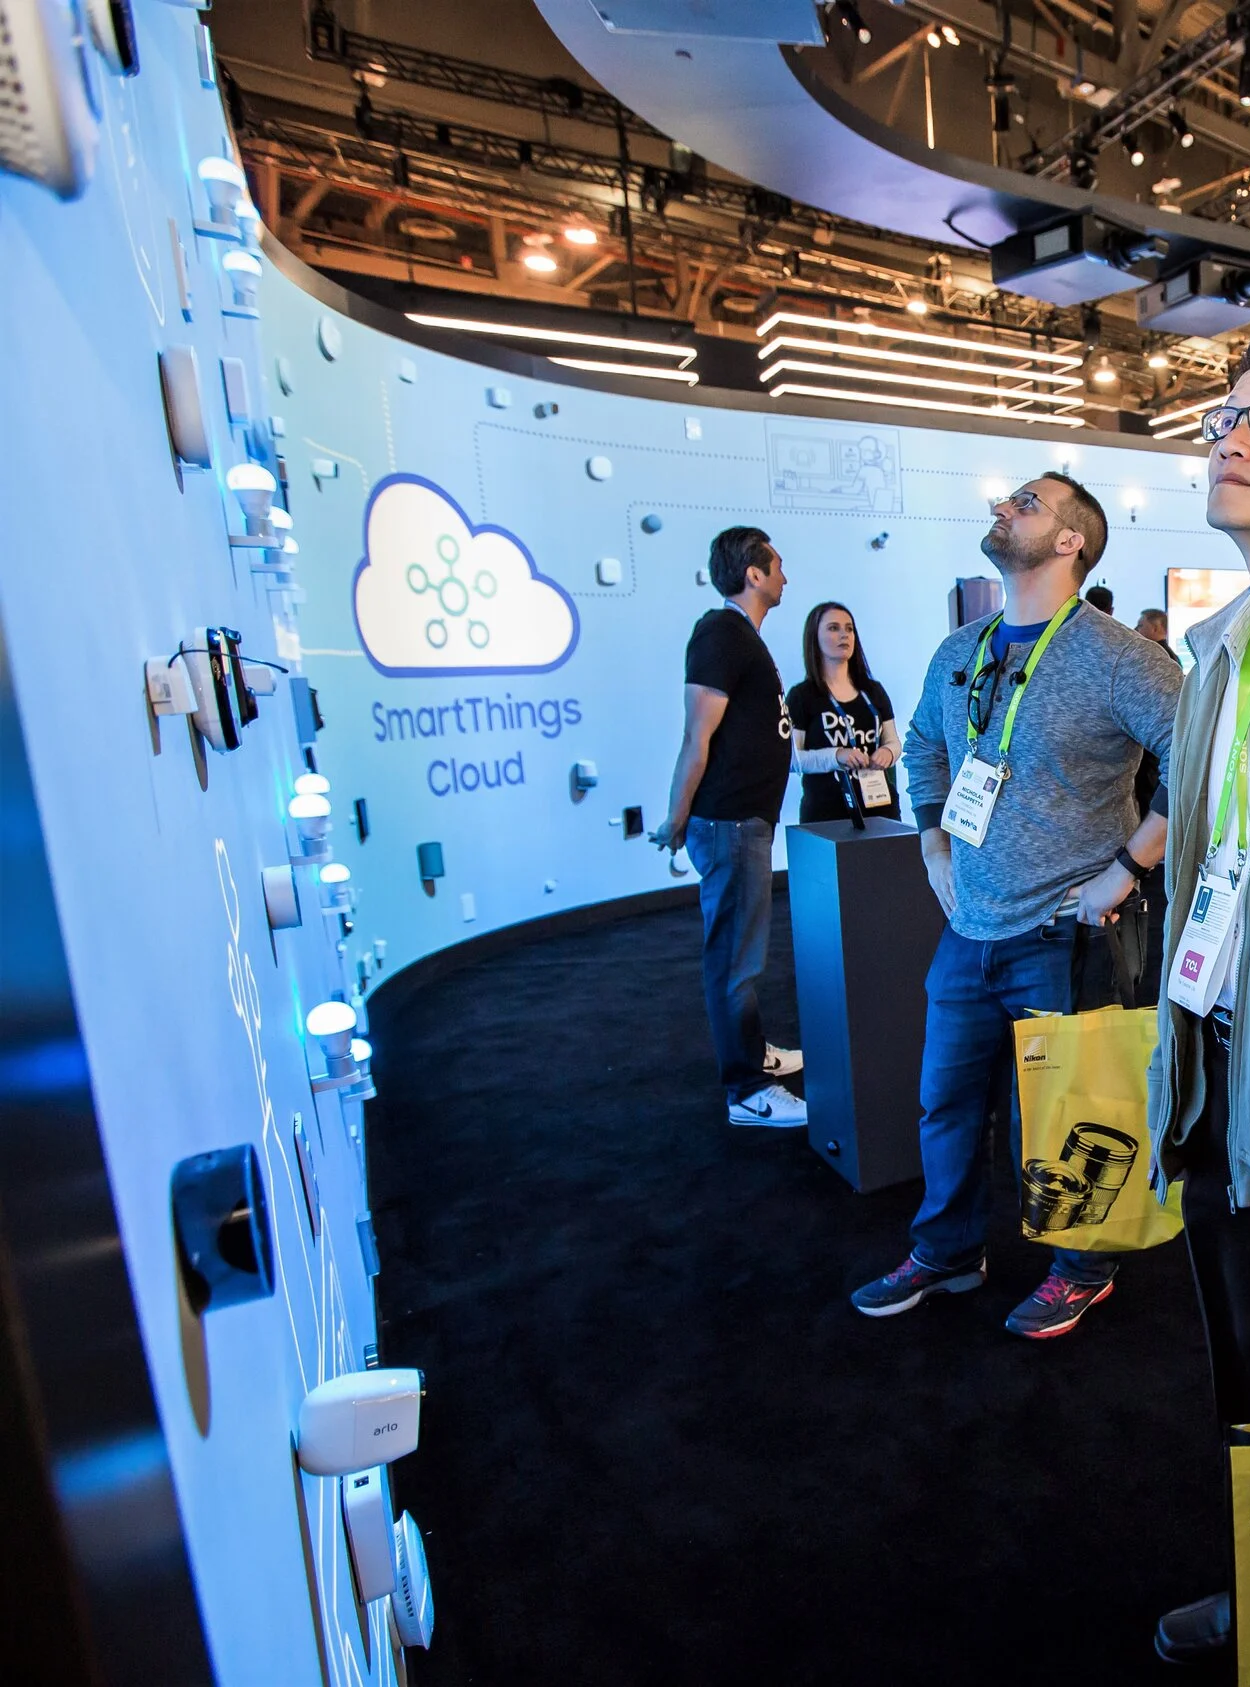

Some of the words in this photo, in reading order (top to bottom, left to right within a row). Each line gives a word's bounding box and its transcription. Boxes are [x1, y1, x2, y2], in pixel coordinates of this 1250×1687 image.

[372, 692, 583, 742] SmartThings
[821, 711, 855, 729] Do
[824, 726, 883, 747] Wha
[1227, 735, 1240, 782] SONY
[427, 750, 526, 797] Cloud
[961, 786, 984, 801] NICHOLAS
[1185, 958, 1198, 973] TCL
[1023, 1055, 1046, 1064] Nikon
[373, 1423, 398, 1437] arlo
